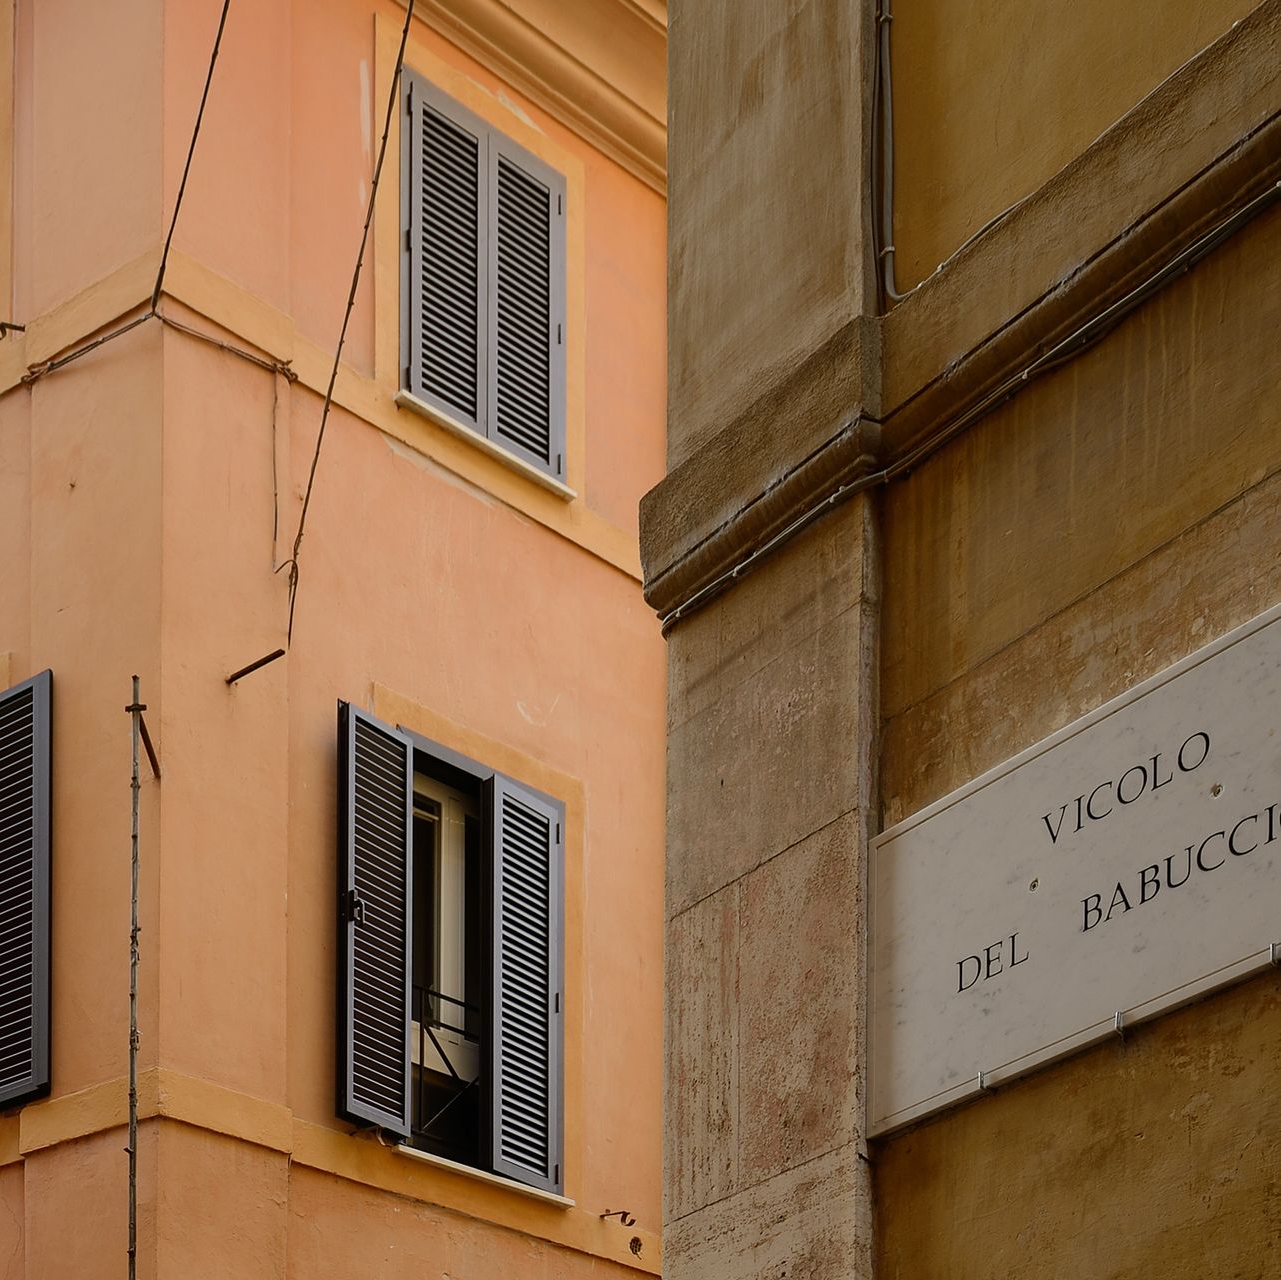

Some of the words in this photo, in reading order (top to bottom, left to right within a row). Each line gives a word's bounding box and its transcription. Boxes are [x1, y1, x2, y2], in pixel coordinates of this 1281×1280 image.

[1041, 731, 1211, 845] VICOLO
[955, 931, 1030, 994] DEL
[1079, 802, 1281, 933] BABUCCI
